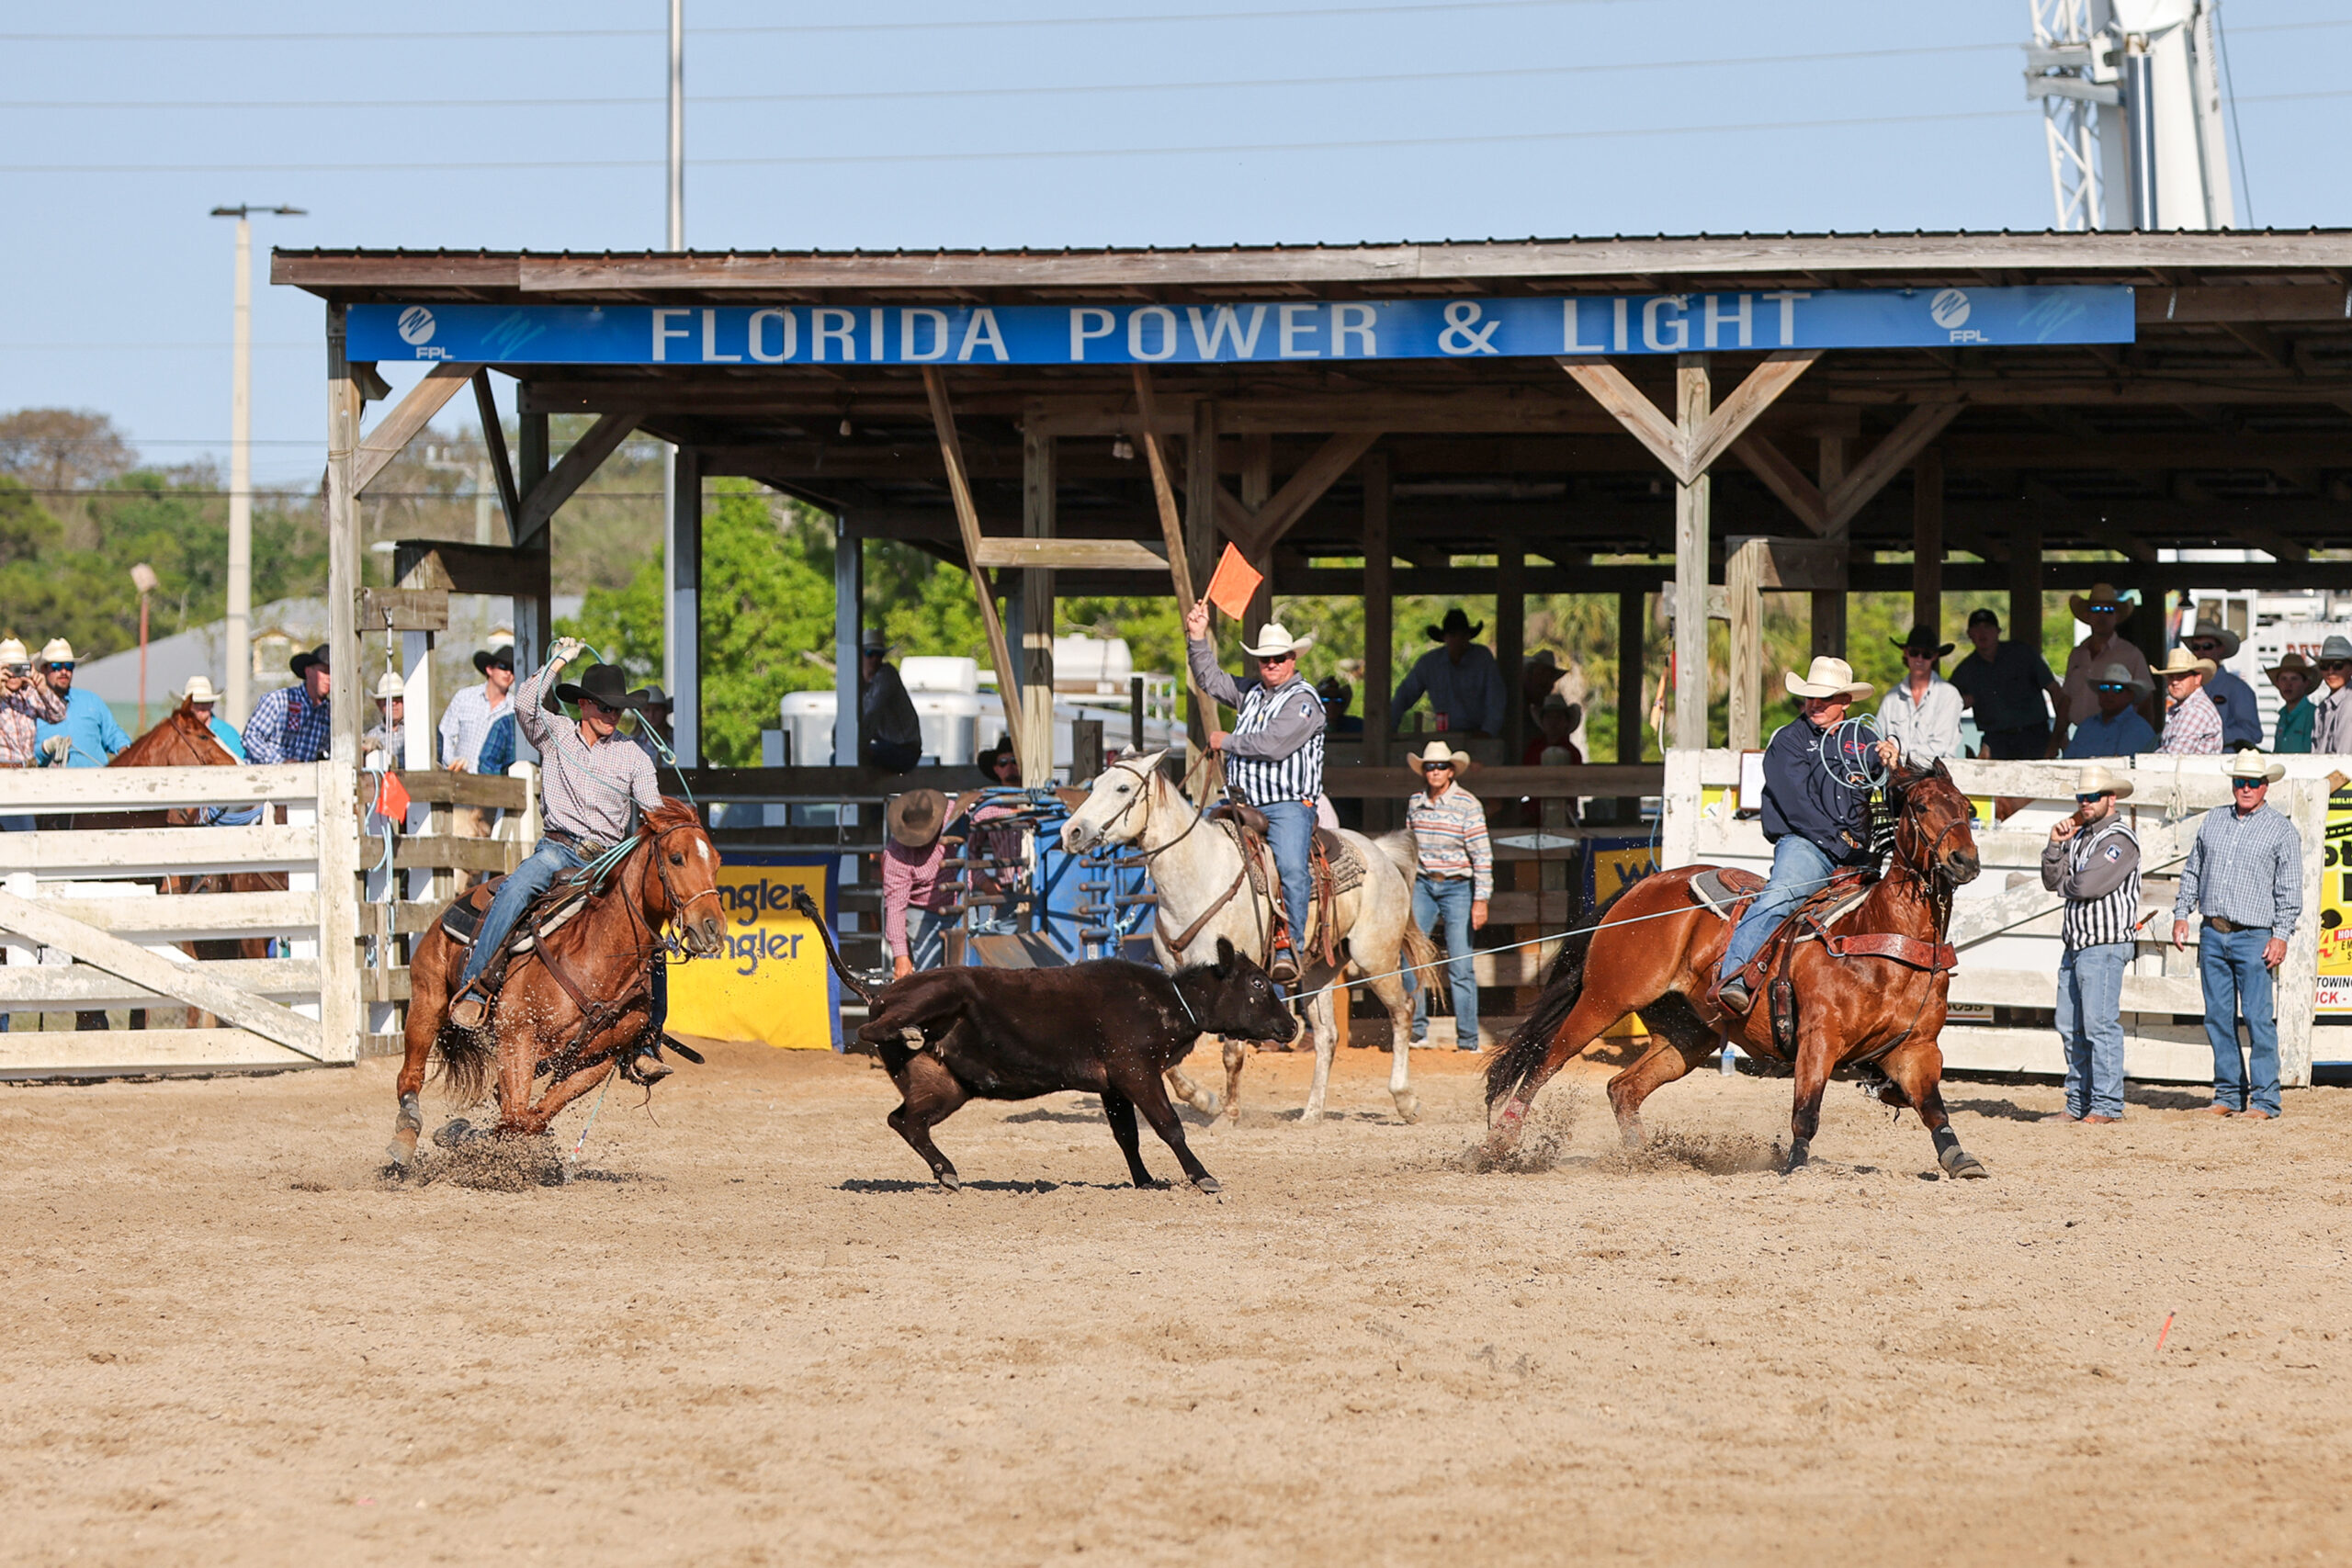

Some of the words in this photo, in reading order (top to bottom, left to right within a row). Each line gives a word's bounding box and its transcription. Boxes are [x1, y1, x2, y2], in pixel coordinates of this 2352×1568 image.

[651, 308, 1010, 362] FLORIDA
[1069, 303, 1377, 361] POWER
[1437, 300, 1501, 355] &
[1564, 292, 1812, 352] LIGHT
[1950, 329, 1989, 343] FPL
[415, 346, 454, 359] FPL
[717, 878, 805, 926] ngler
[698, 928, 804, 976] ngler
[2316, 976, 2352, 988] TOWIN
